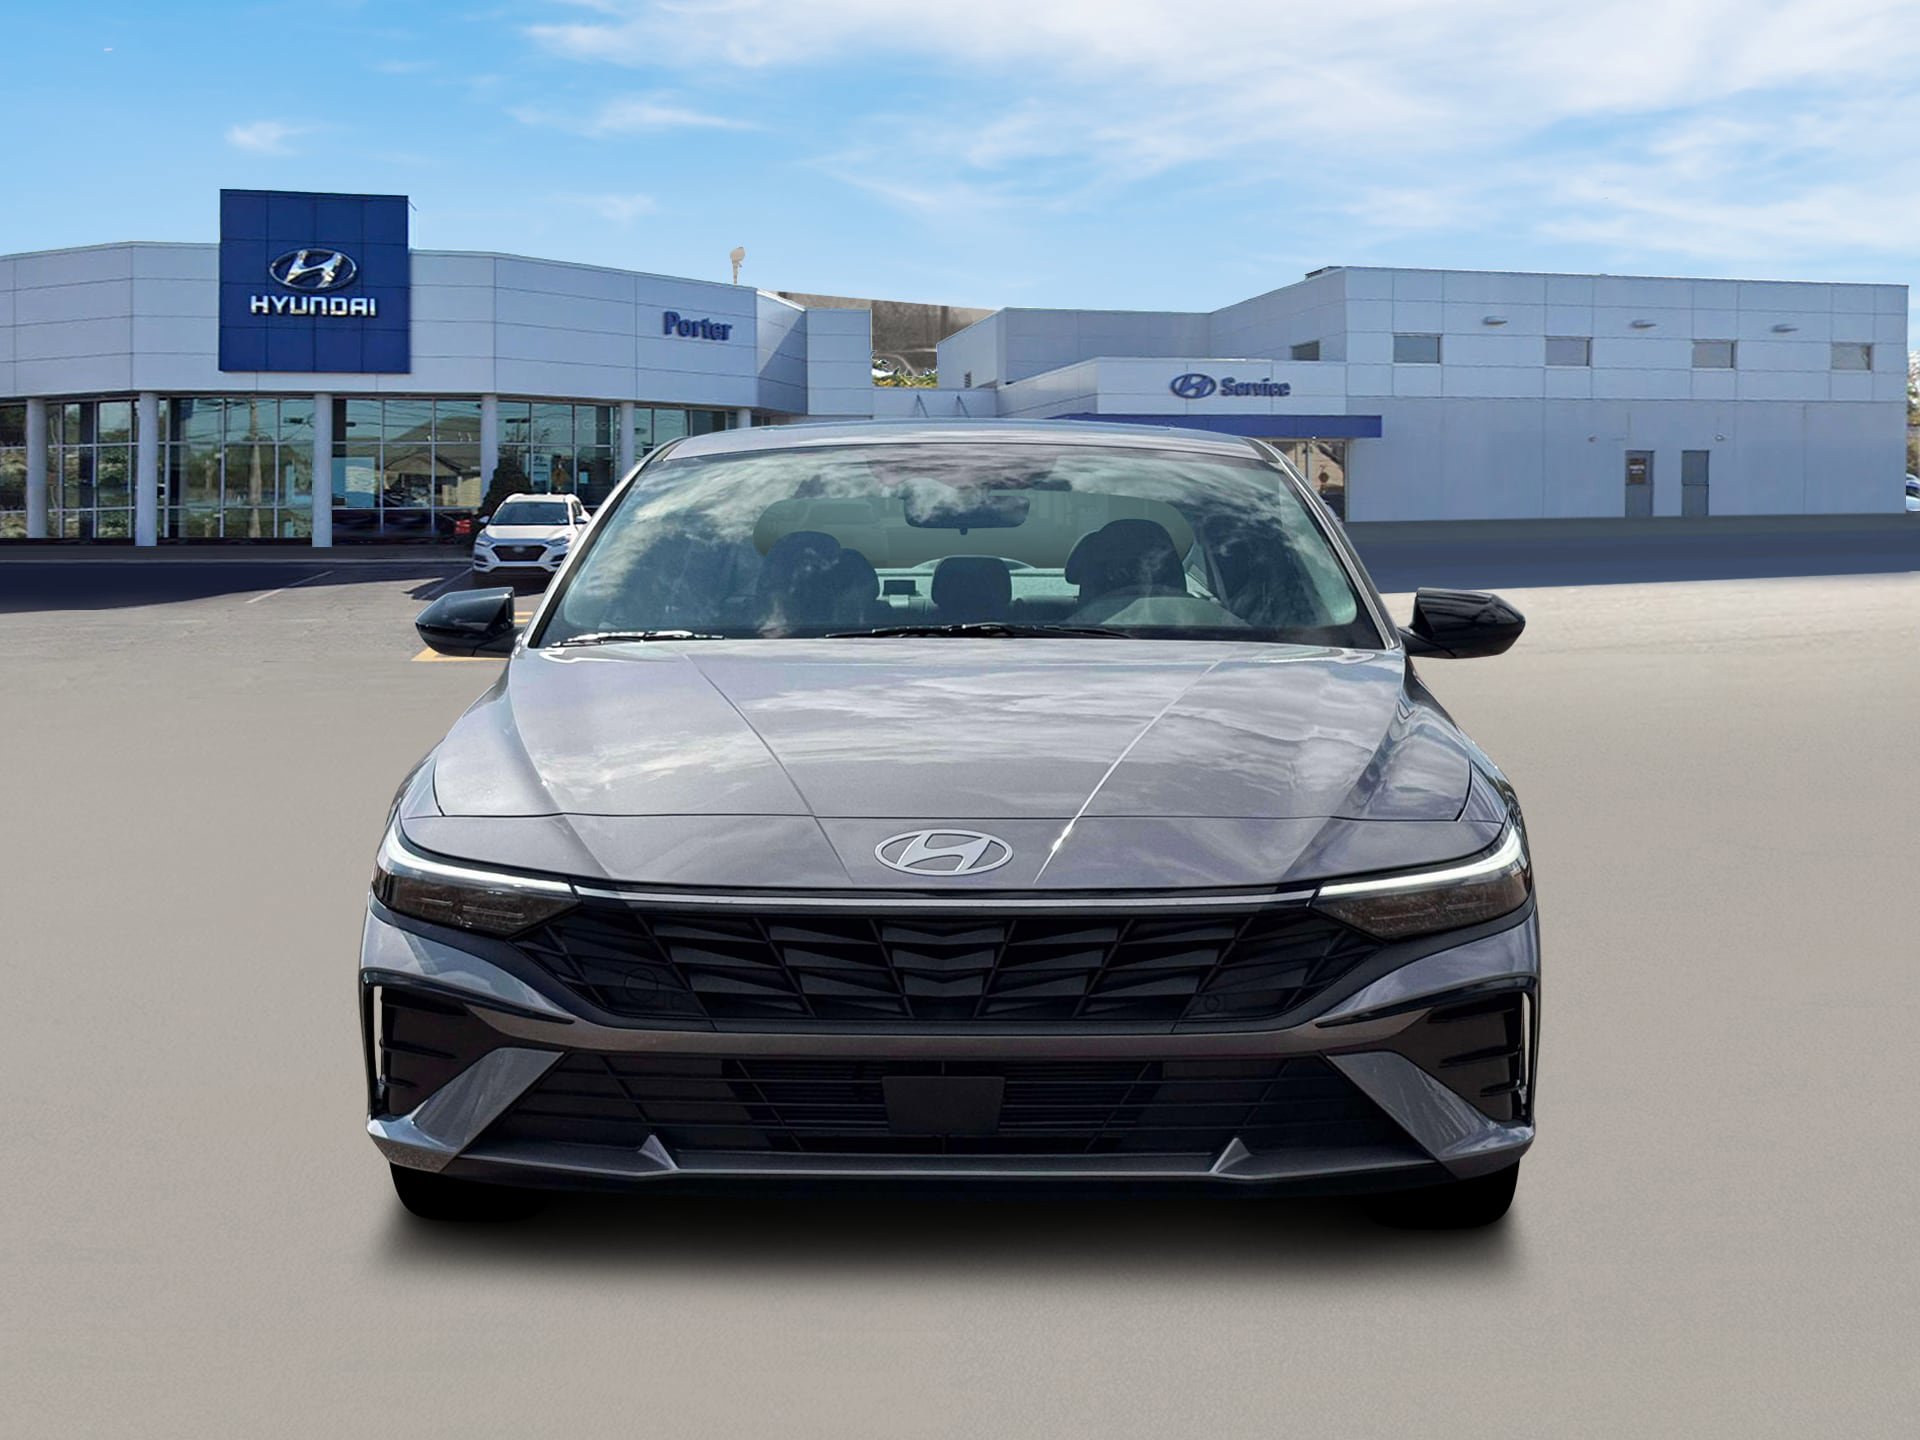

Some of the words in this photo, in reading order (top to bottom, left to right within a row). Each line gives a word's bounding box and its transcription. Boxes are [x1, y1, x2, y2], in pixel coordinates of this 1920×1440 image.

[250, 295, 377, 317] HYUNDAI
[663, 311, 733, 341] Porter
[1220, 377, 1291, 397] Service
